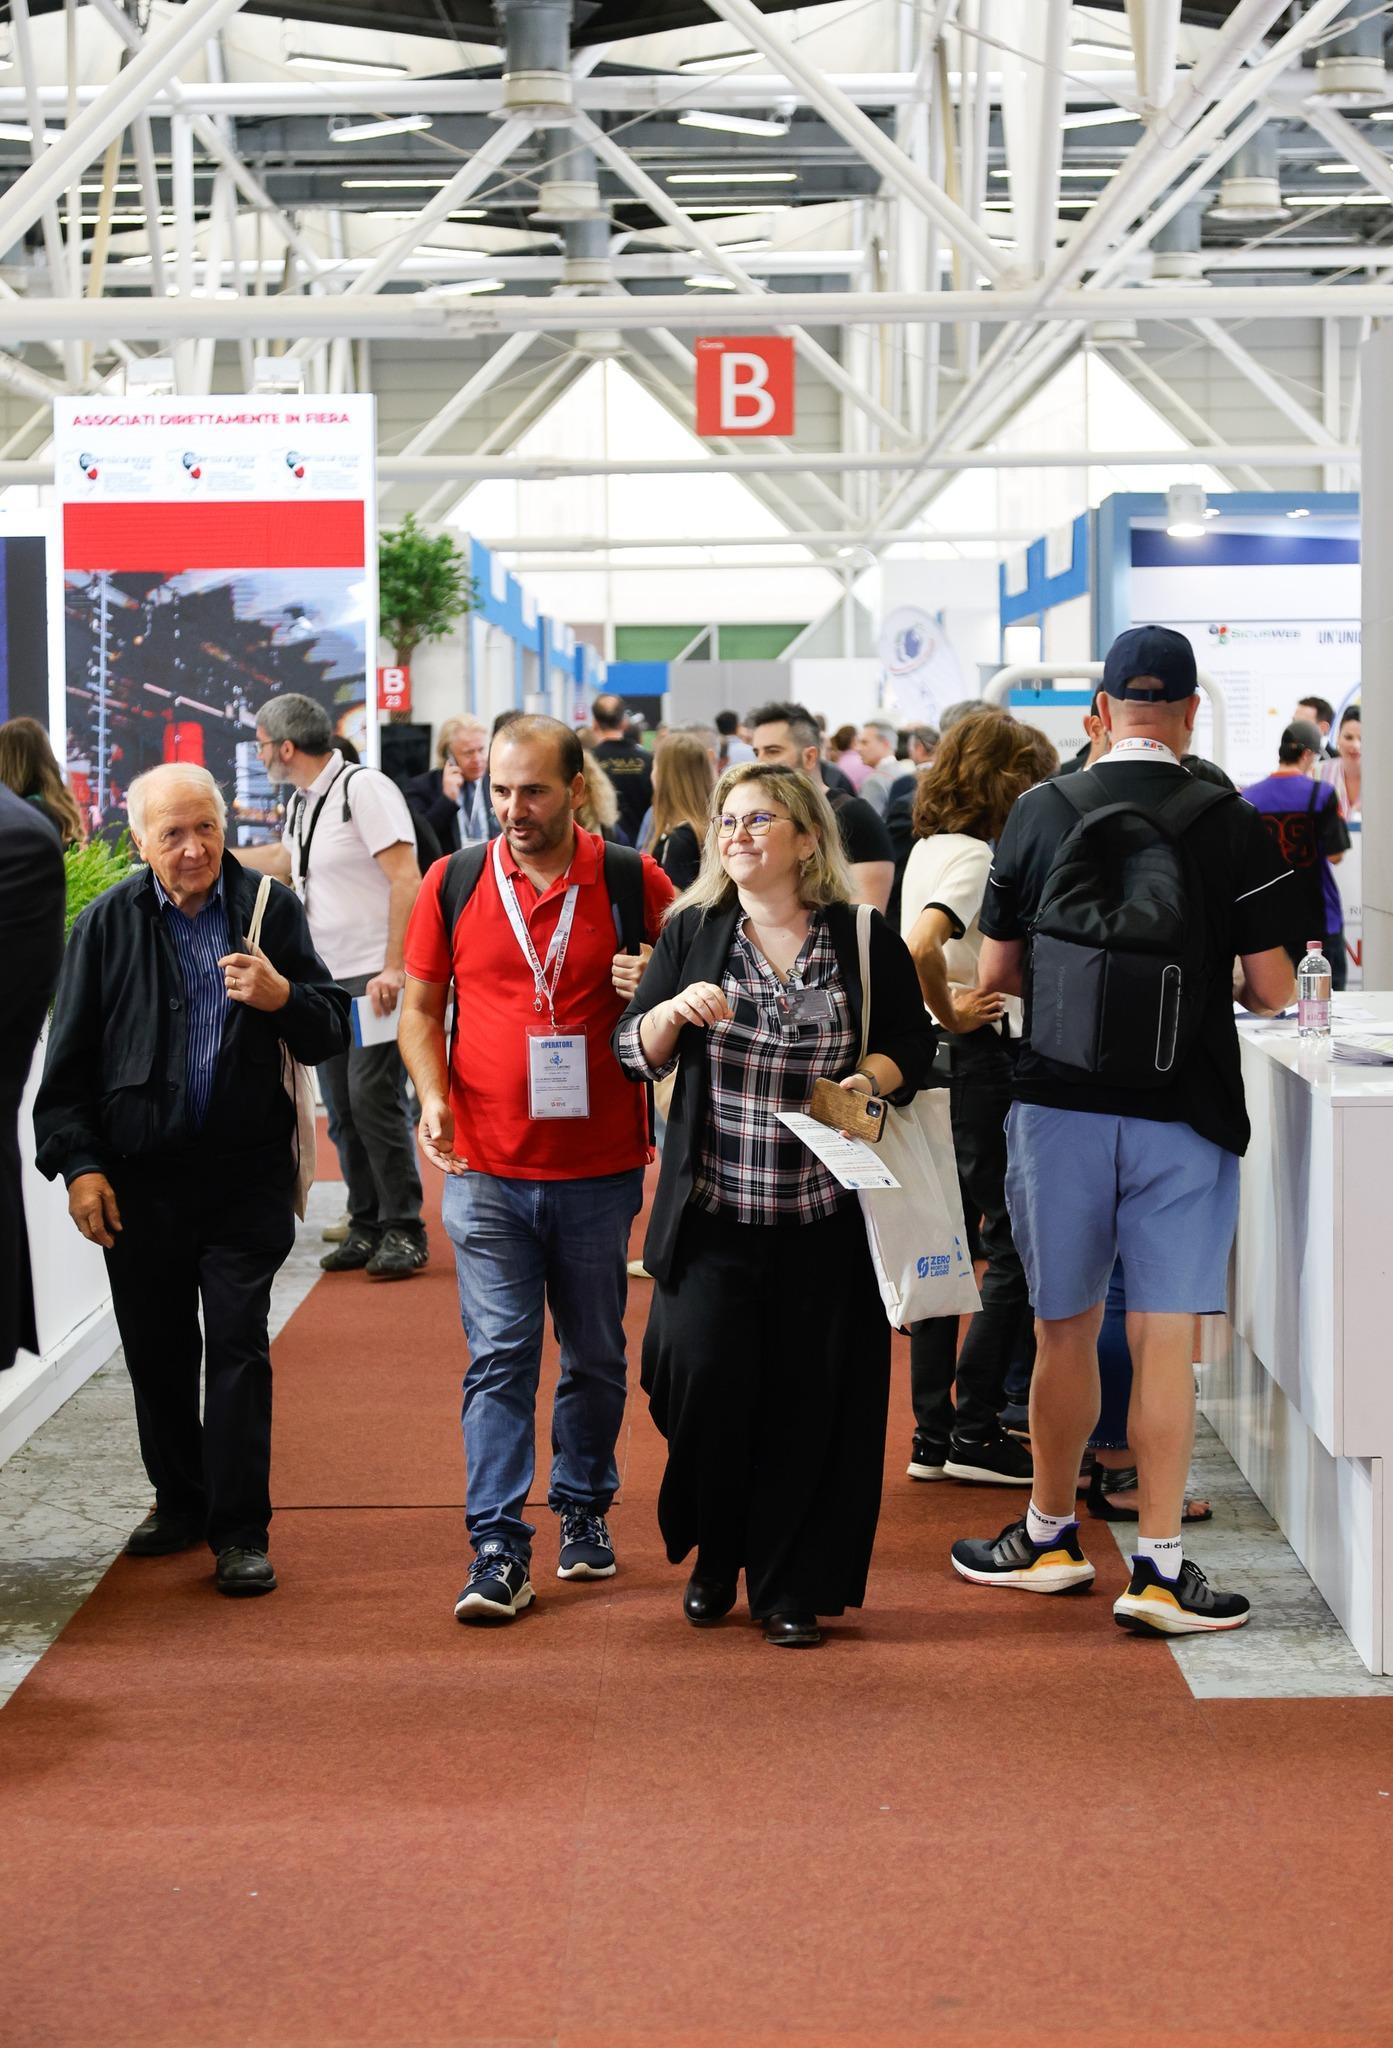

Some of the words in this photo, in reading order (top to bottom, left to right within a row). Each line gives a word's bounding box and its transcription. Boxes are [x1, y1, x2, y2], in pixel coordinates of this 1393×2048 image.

[720, 352, 776, 430] B
[73, 414, 155, 426] ASSOCIATI
[160, 413, 279, 425] DIRETTAMENTE
[286, 413, 299, 424] IN
[306, 412, 349, 424] FIERA
[383, 669, 406, 694] B
[541, 1041, 573, 1049] OPERATORE
[930, 1254, 950, 1265] ZERO
